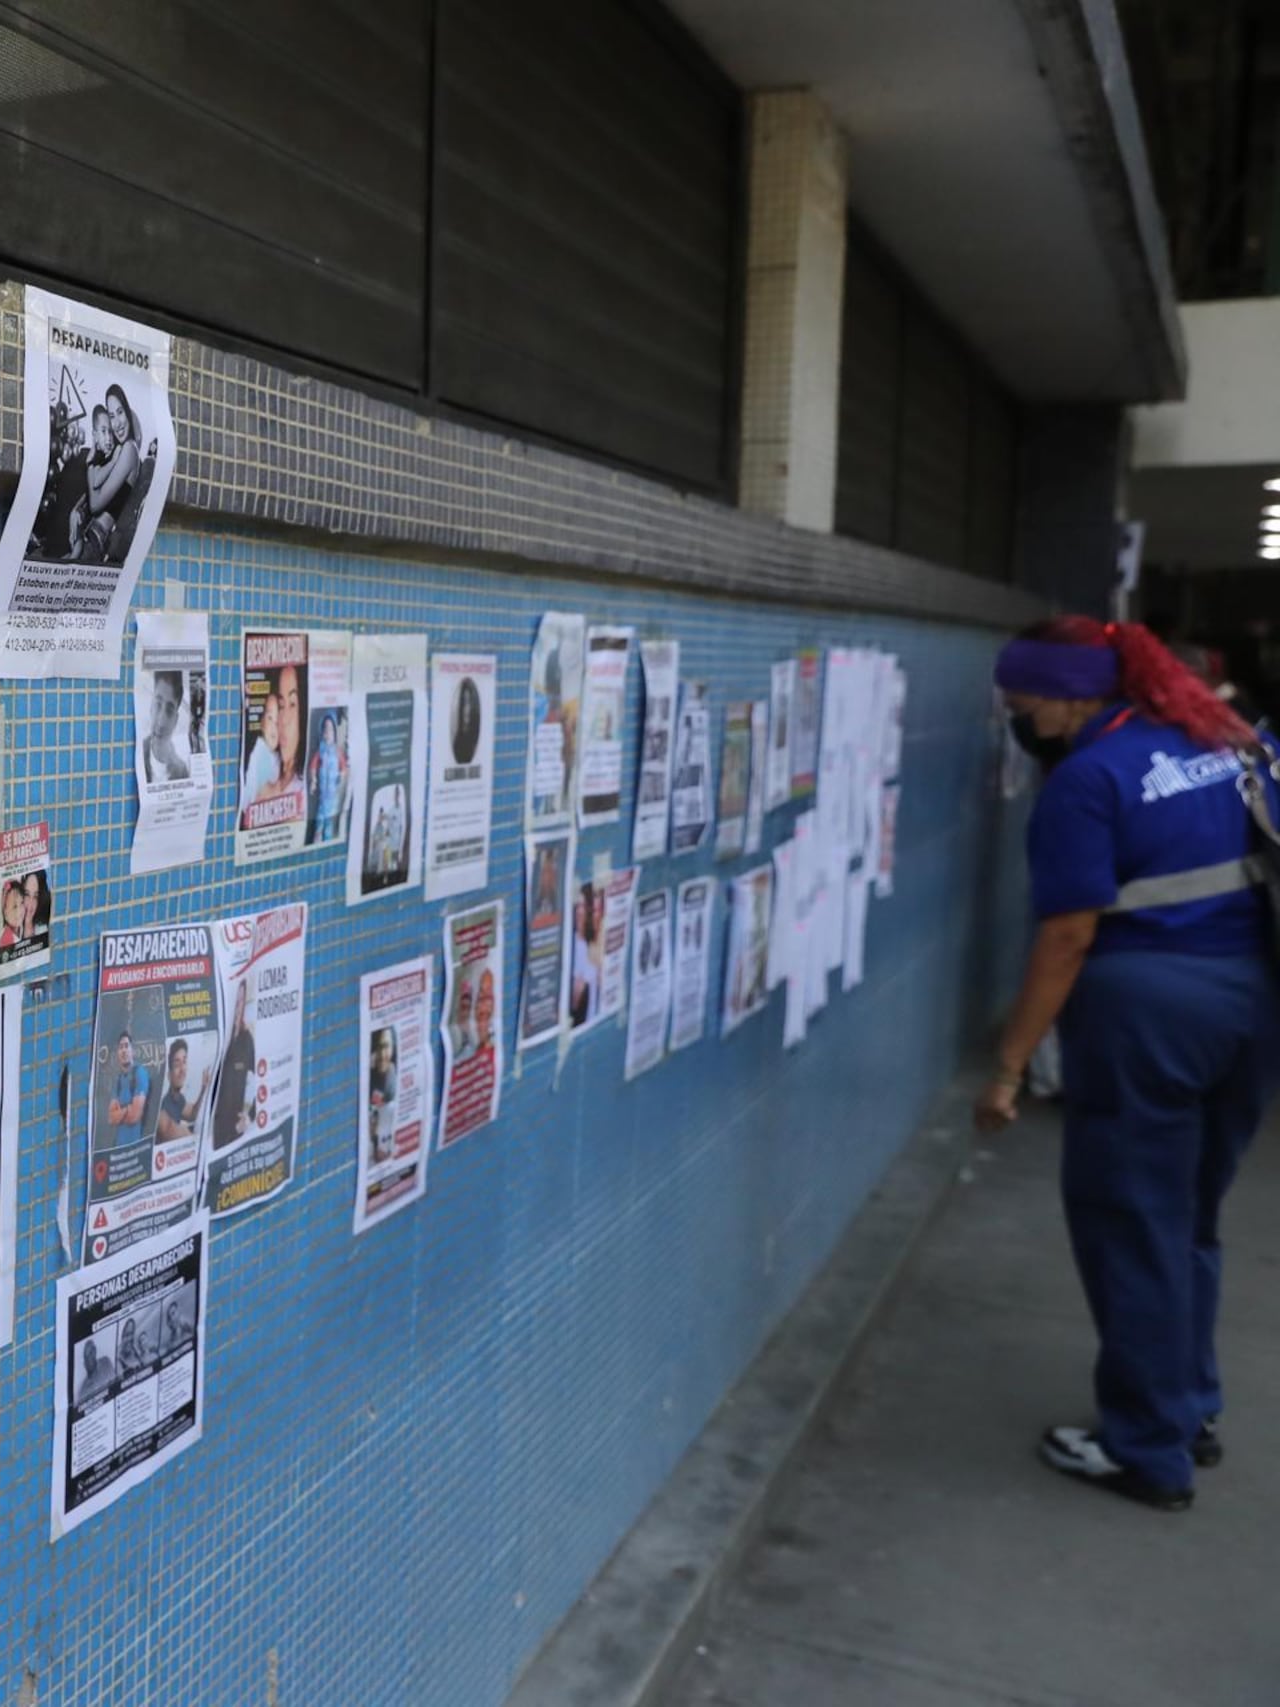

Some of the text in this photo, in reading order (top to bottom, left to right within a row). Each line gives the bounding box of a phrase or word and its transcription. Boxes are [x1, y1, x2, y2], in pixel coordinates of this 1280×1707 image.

[52, 327, 149, 371] DESAPARECIDOS
[18, 577, 49, 589] Estaban
[105, 928, 209, 966] DESAPARECIDO
[108, 966, 146, 986] AYÚDANOS
[258, 965, 287, 992] LIZMAR
[257, 989, 299, 1020] RODRÍGUEZ
[77, 1274, 127, 1312] PERSONAS
[129, 1238, 194, 1286] DESAPARECIDAS
